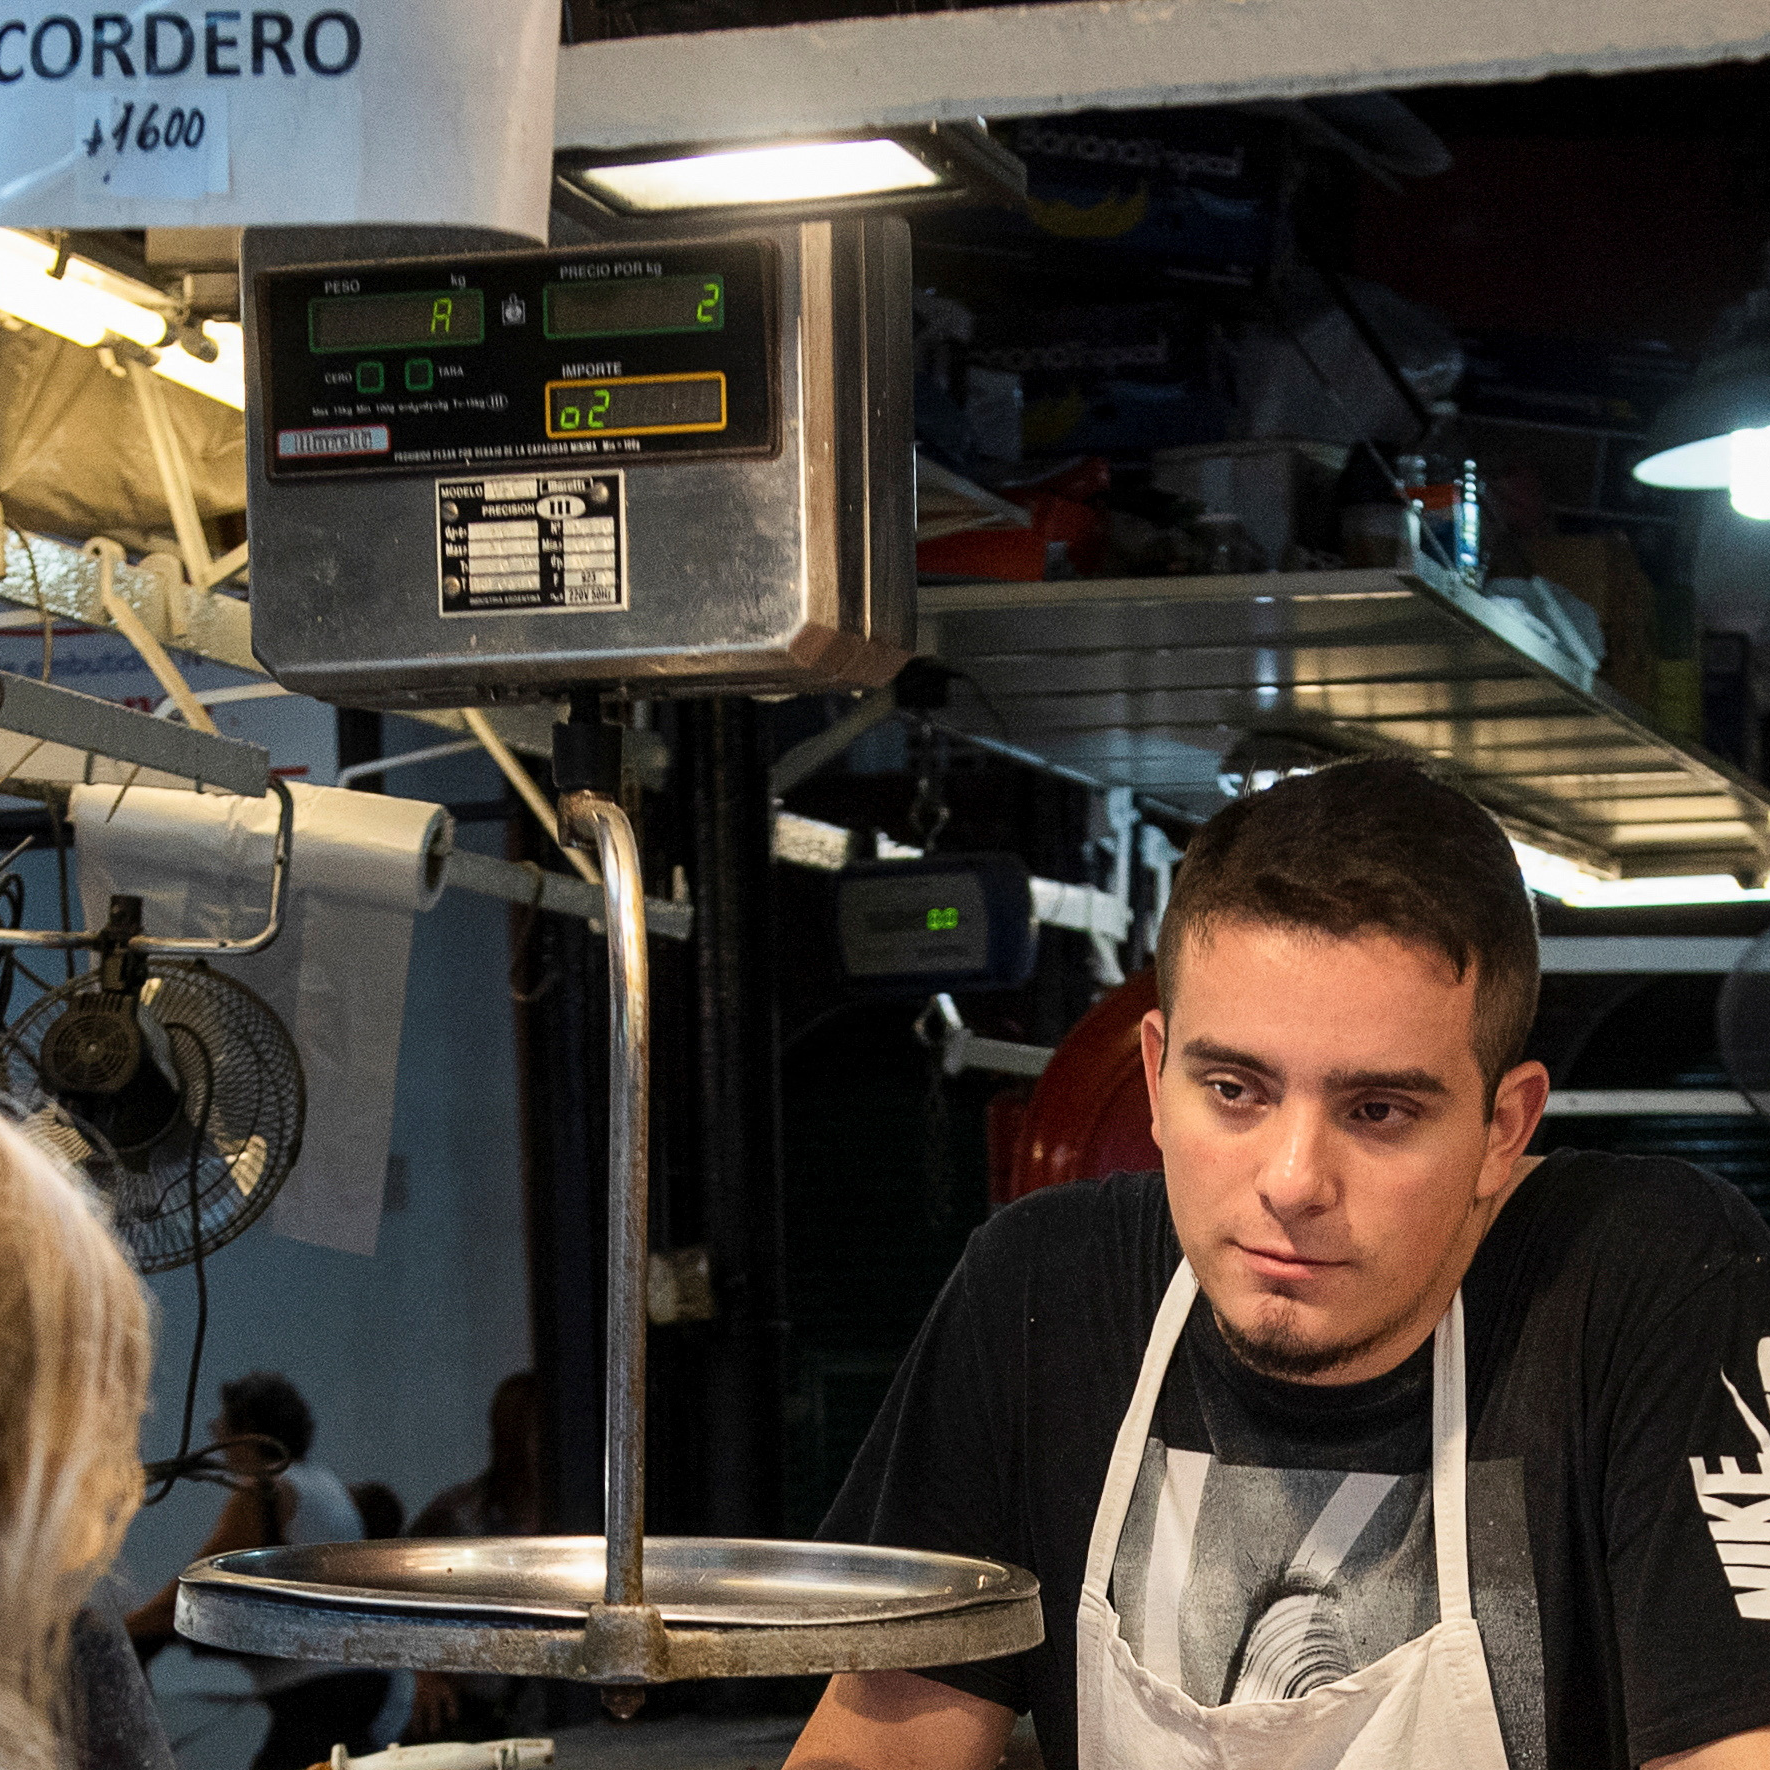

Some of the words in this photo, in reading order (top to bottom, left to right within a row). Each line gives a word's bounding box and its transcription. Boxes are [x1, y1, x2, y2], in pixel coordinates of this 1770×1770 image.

[560, 264, 610, 280] PRECIO
[614, 262, 642, 277] POR
[324, 279, 360, 295] PESO
[450, 273, 467, 288] kg
[696, 283, 720, 323] 2
[431, 298, 453, 333] A
[324, 372, 352, 385] CERO
[438, 365, 464, 378] TARA
[561, 361, 622, 379] IMPORTE
[440, 486, 483, 499] MODELO
